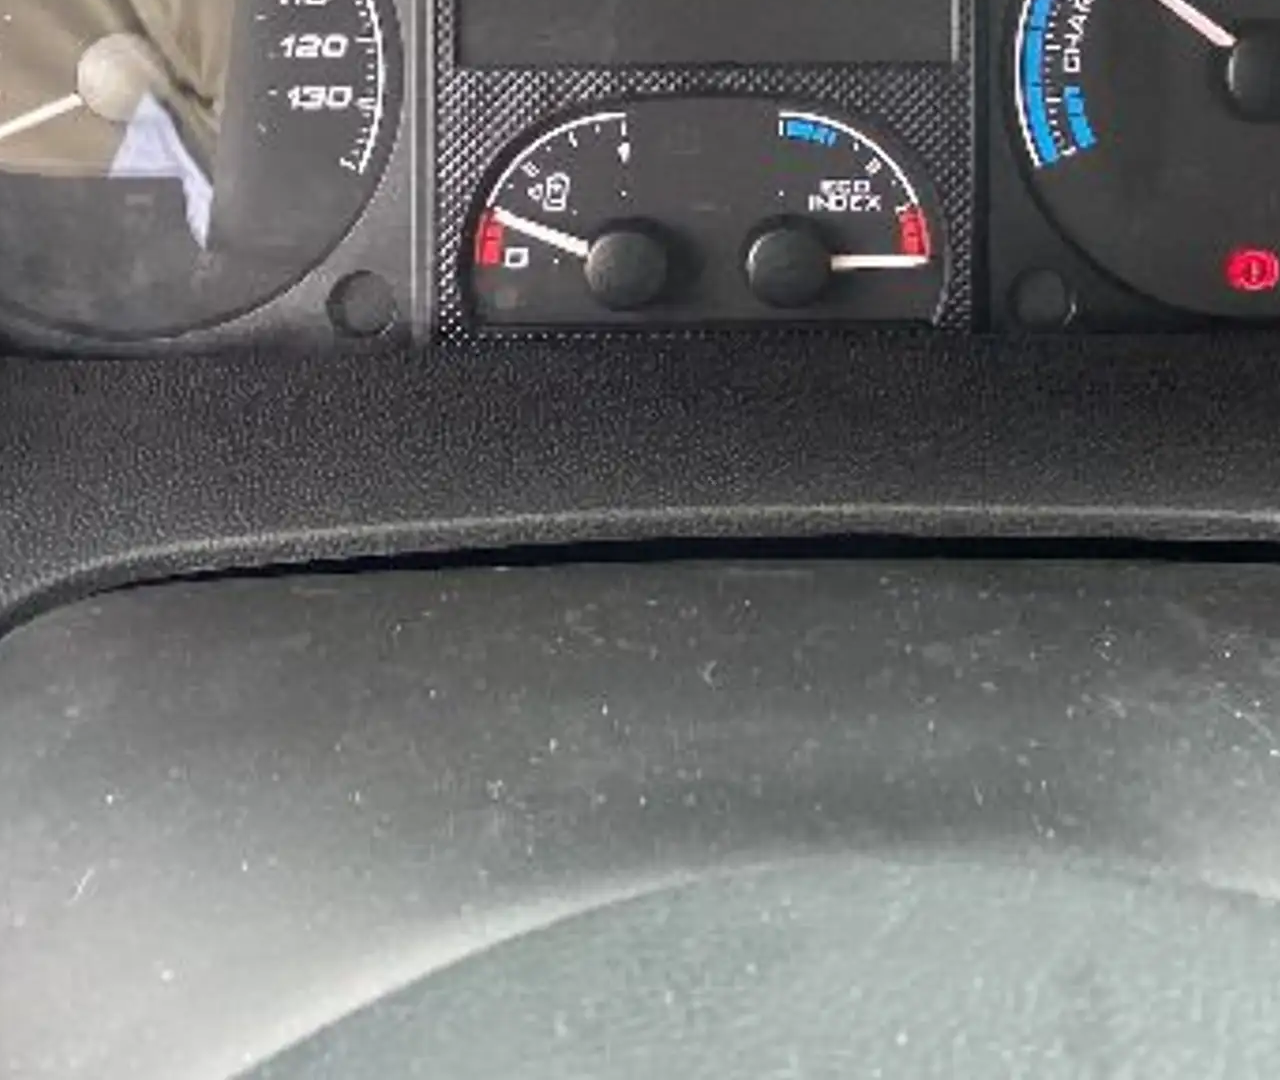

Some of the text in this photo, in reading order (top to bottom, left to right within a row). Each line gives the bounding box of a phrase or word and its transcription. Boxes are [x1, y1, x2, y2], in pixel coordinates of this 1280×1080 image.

[279, 34, 349, 59] 120
[286, 86, 353, 109] 130
[820, 179, 872, 194] ECO
[807, 194, 882, 212] INDEX
[504, 247, 529, 268] 0
